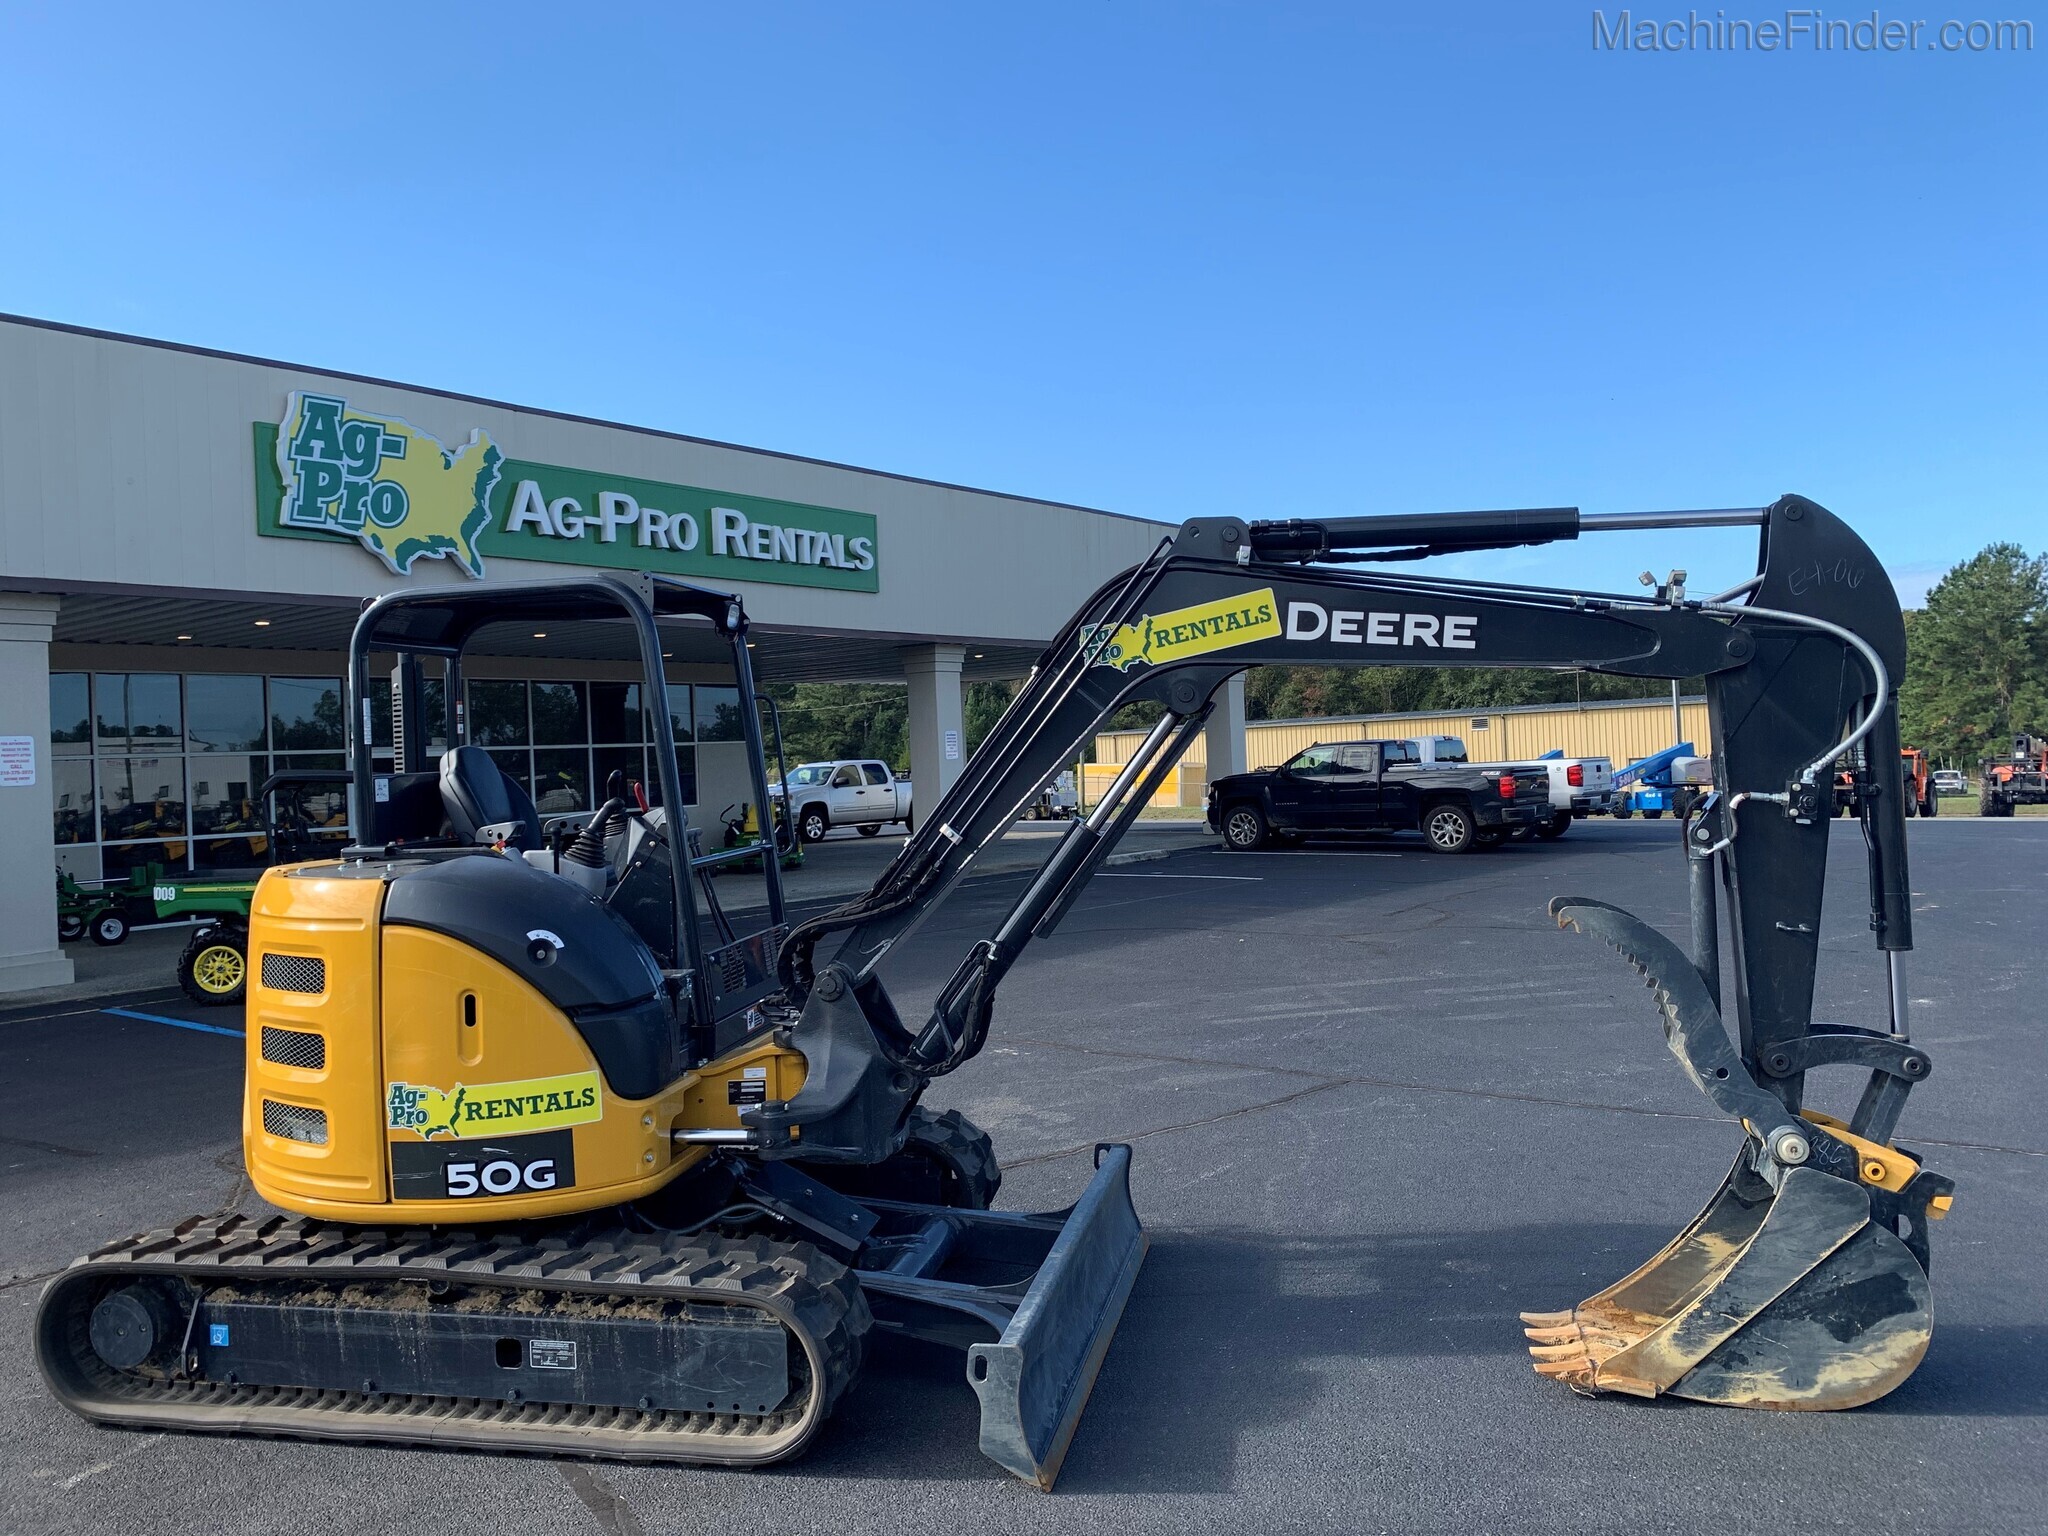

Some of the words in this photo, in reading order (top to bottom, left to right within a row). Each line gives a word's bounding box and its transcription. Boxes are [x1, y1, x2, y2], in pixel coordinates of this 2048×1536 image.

[289, 396, 406, 478] Ag-
[291, 460, 409, 528] Pro
[505, 480, 699, 551] AG-PRO
[711, 506, 874, 571] RENTALS
[1153, 604, 1272, 648] RENTALS
[1286, 601, 1478, 649] DEERE
[389, 1083, 428, 1108] Ag-
[389, 1105, 429, 1127] Pro
[464, 1087, 595, 1121] RENTALS
[447, 1159, 556, 1196] 50G
